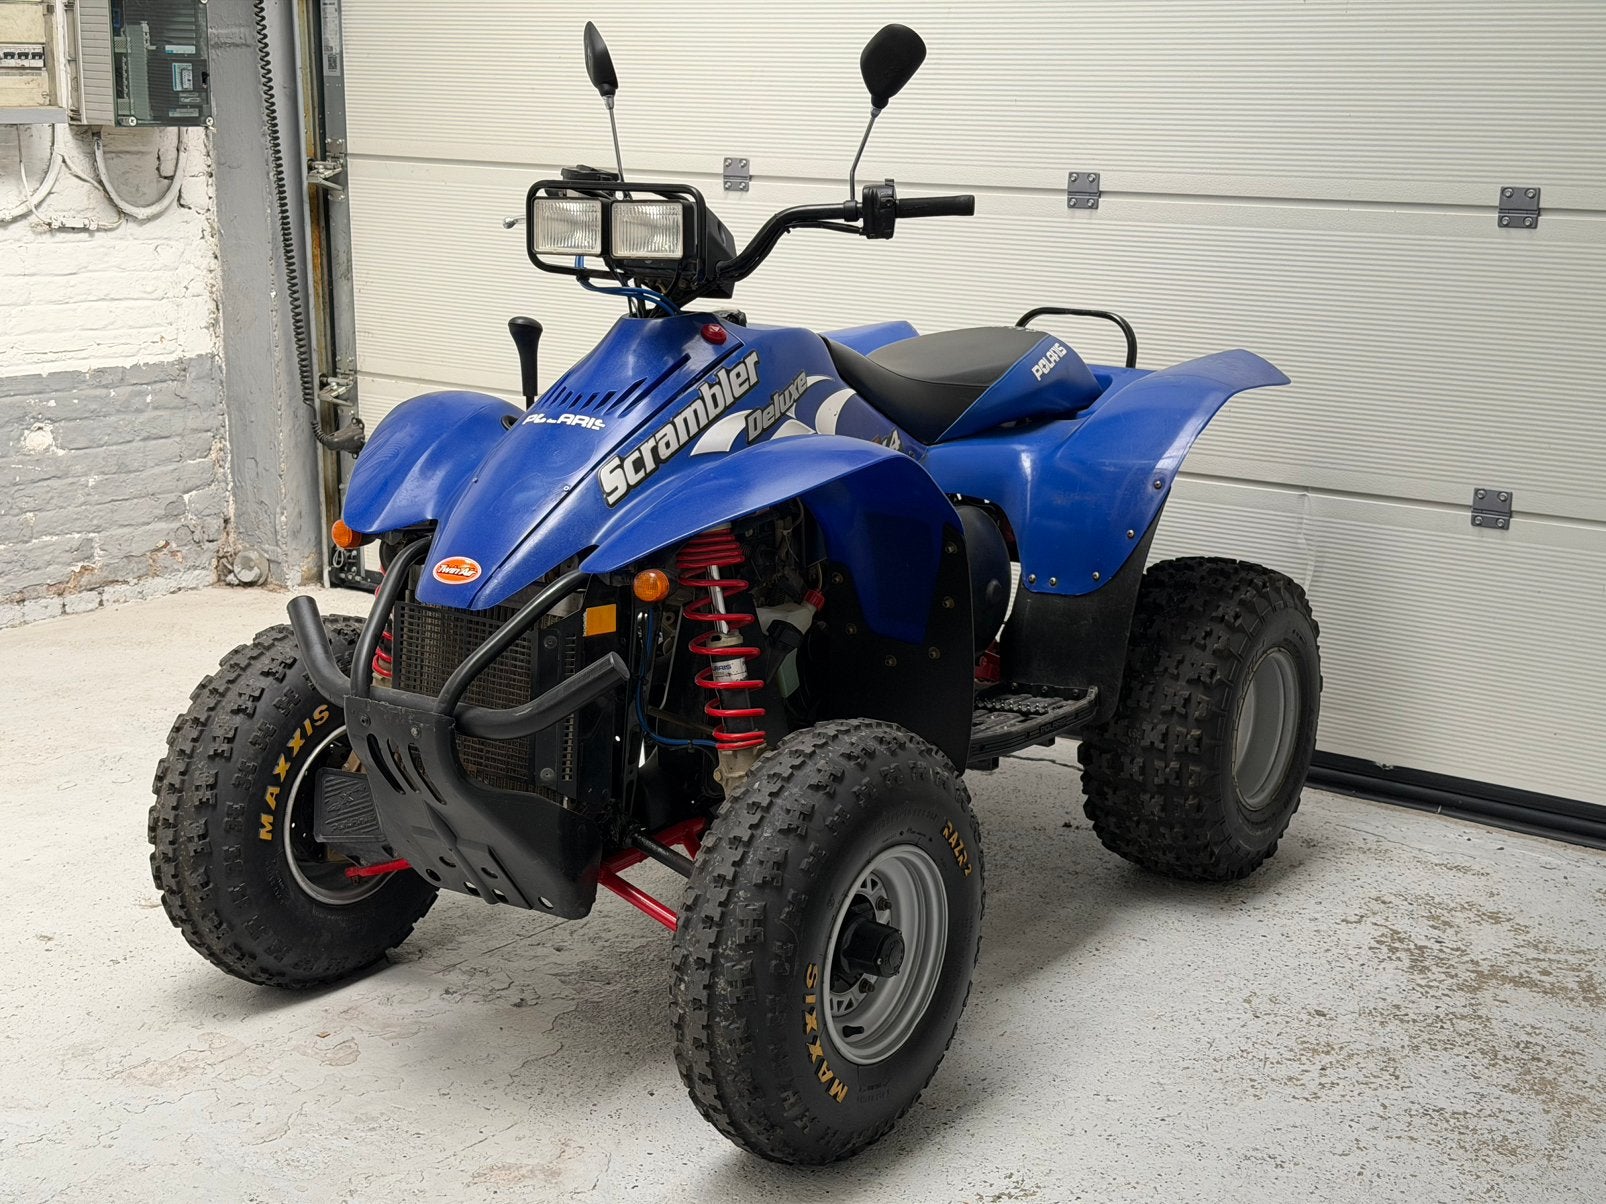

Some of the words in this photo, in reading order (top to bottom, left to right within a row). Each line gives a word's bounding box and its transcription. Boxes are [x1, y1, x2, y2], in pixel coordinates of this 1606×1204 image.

[598, 350, 760, 507] Scrambler
[746, 373, 808, 443] Deluxe
[1031, 342, 1067, 381] POLARIS
[259, 704, 329, 841] MAXXIS
[805, 962, 849, 1104] MAXXIS
